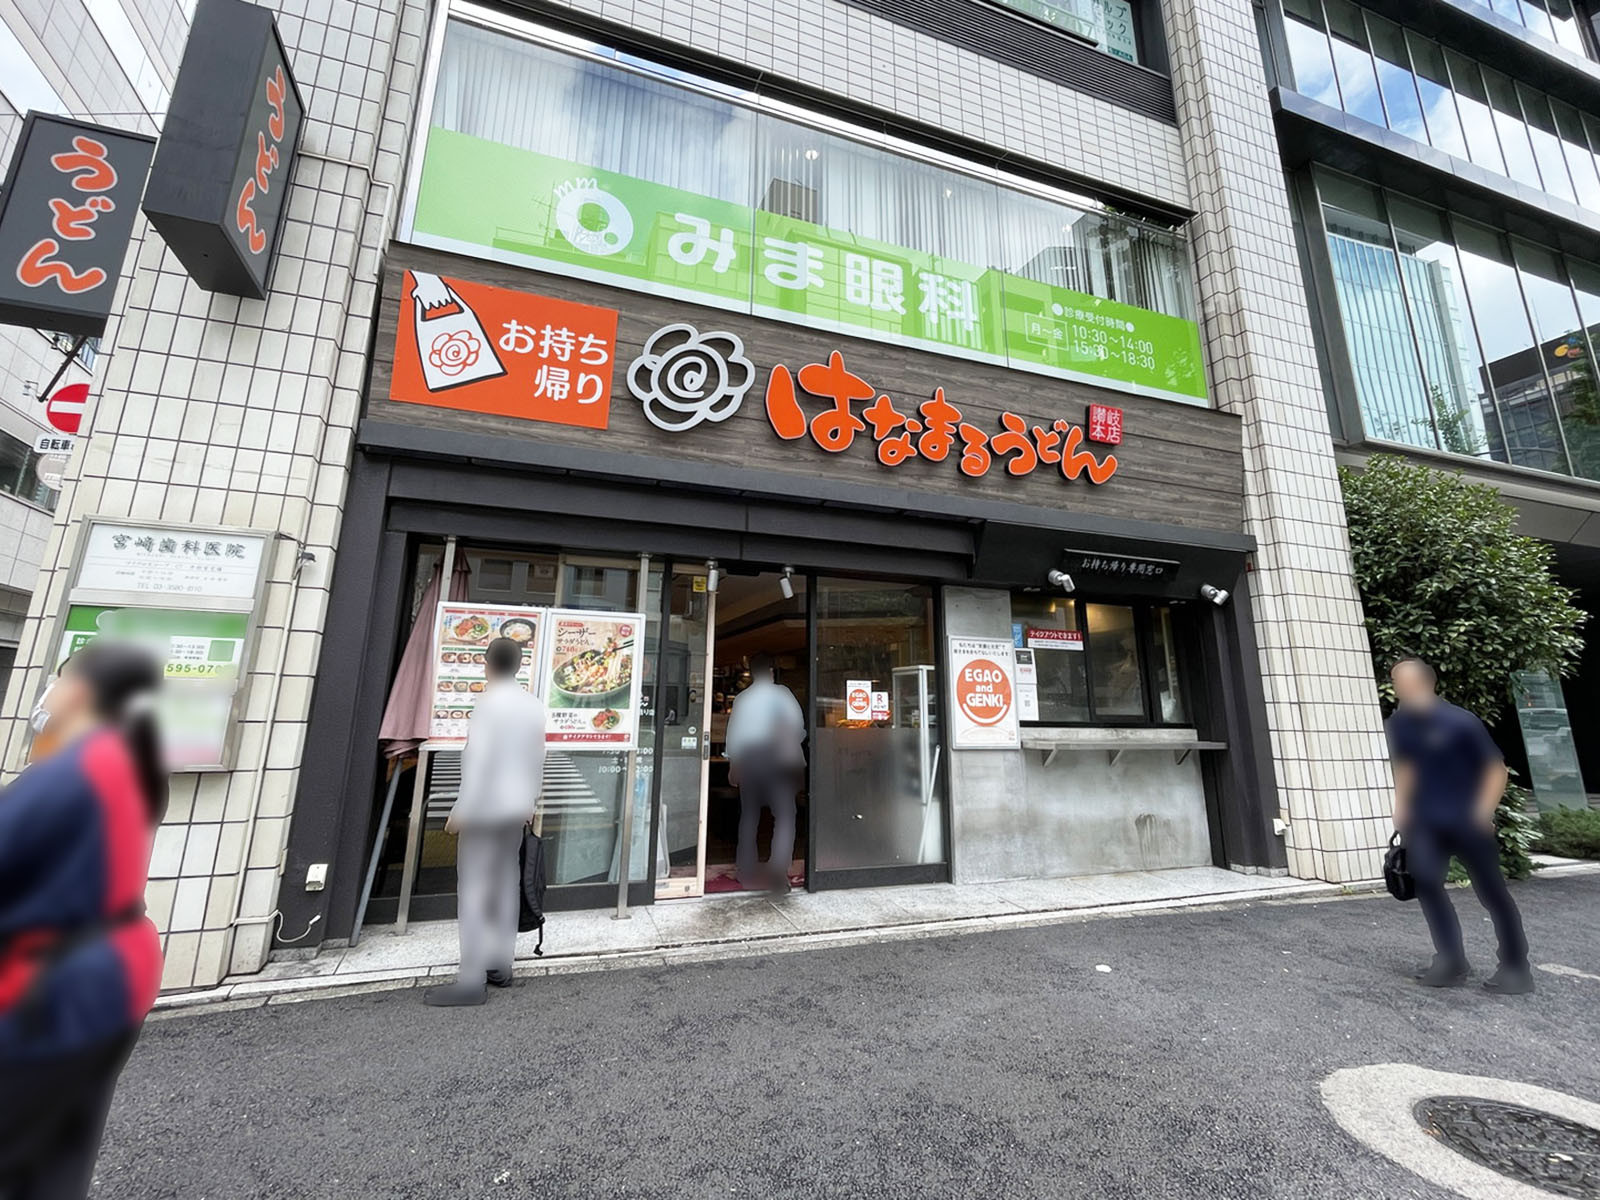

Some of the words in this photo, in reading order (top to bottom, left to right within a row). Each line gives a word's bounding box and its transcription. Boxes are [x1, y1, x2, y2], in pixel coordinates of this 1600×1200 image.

[237, 64, 286, 254] うどん
[17, 136, 117, 293] うどん
[667, 212, 980, 333] みま眼科
[499, 319, 610, 366] お持ち
[533, 364, 605, 405] 帰り
[765, 350, 1118, 485] はなまるうどん
[40, 438, 74, 451] 自転車
[557, 627, 596, 638] シーザー
[964, 668, 1003, 683] EGAO
[975, 683, 993, 693] and
[965, 692, 1004, 707] GENKI
